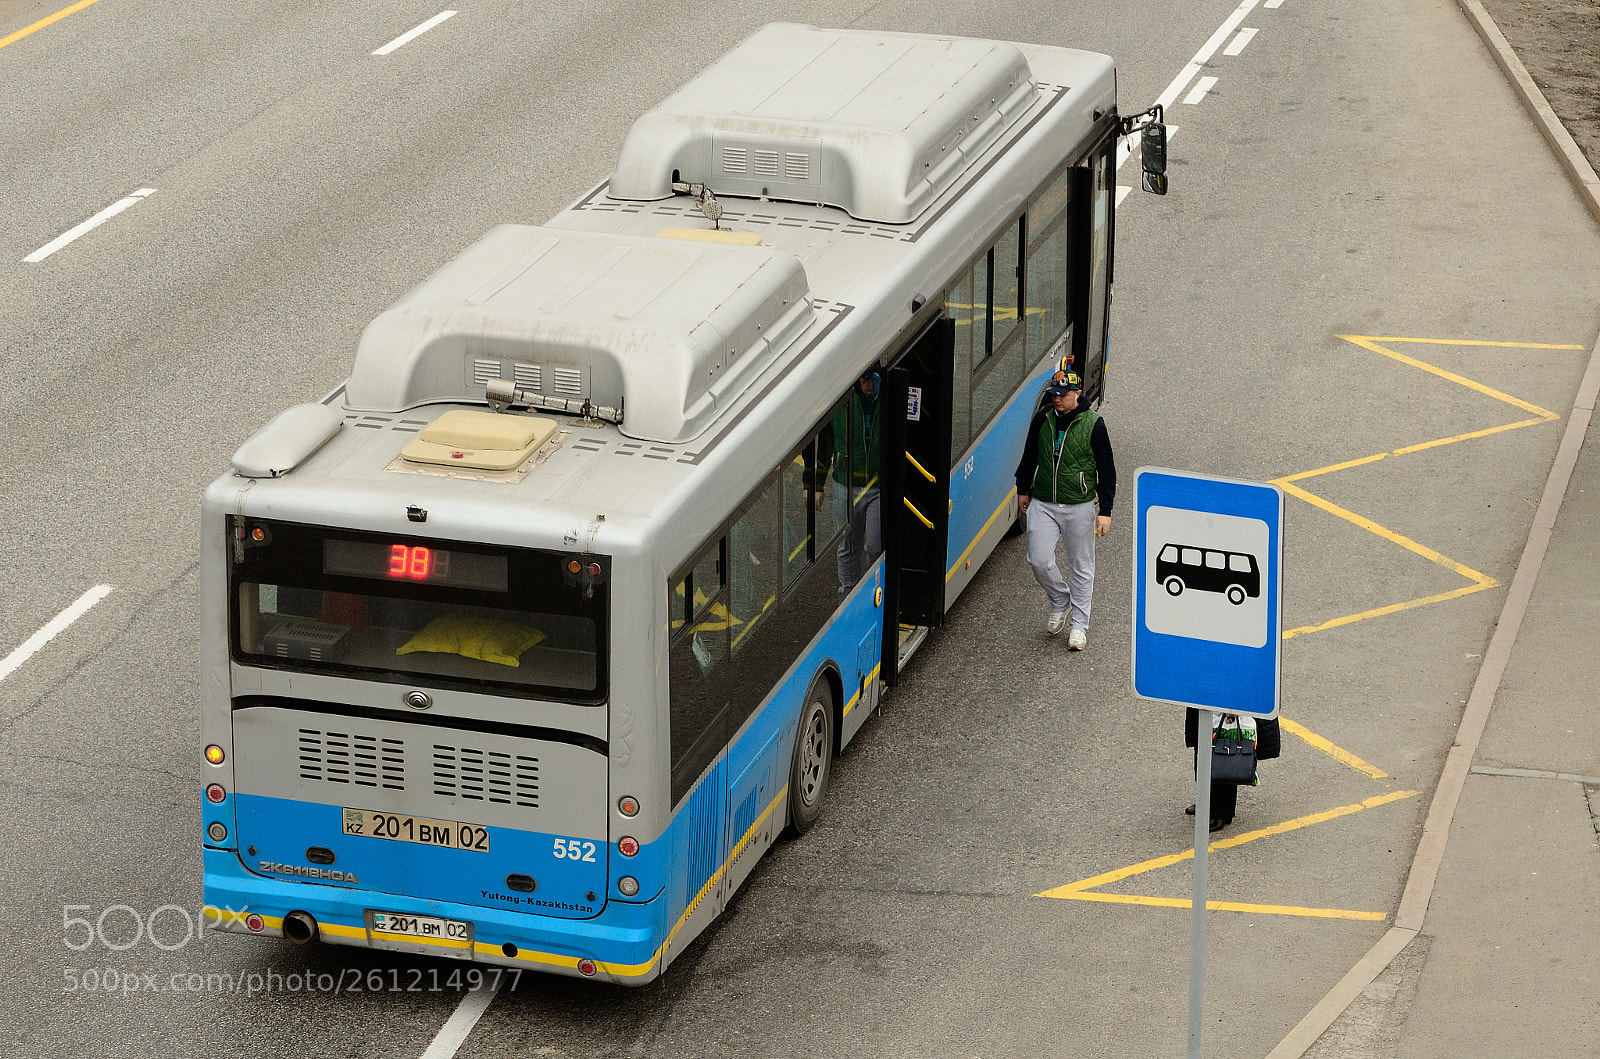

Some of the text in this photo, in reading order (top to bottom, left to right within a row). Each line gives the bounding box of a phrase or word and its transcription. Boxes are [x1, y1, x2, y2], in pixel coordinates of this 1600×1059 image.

[389, 544, 429, 578] 38
[346, 814, 488, 850] KZ 201 BM 02
[552, 838, 596, 863] 552
[256, 860, 359, 884] ZK6118HGA
[481, 890, 593, 913] Yutong-Kazakhstan
[374, 916, 467, 938] KZ 201 BM 02
